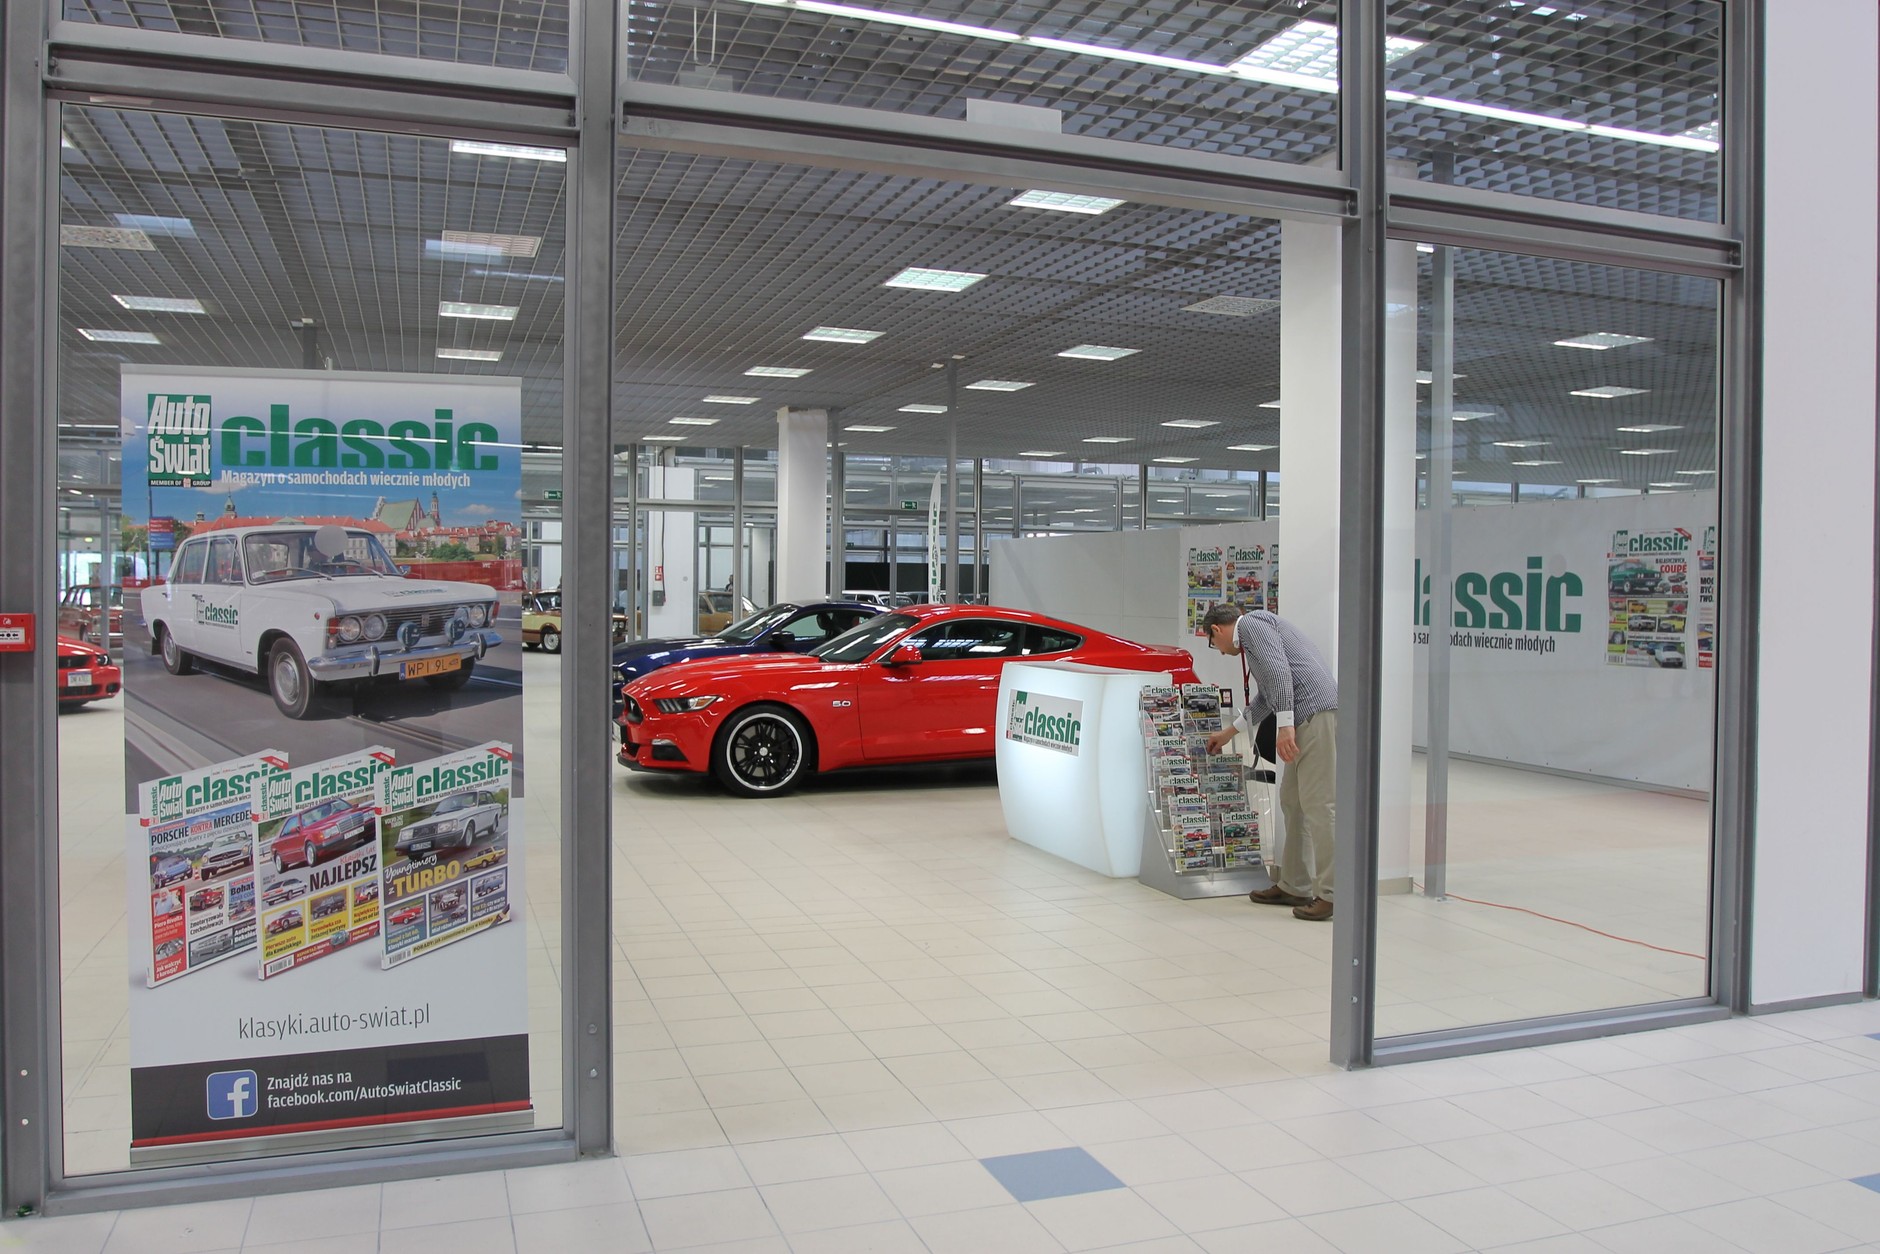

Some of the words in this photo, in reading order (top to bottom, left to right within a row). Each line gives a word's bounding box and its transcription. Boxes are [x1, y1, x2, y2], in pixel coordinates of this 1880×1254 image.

[148, 396, 210, 435] Auto
[221, 404, 498, 470] classic
[149, 435, 211, 474] Świat
[221, 470, 278, 485] Magazyn
[278, 473, 285, 483] o
[288, 470, 367, 485] samochodach
[370, 471, 419, 486] wiecznie
[422, 473, 470, 489] młodych
[1629, 533, 1688, 552] classic
[205, 603, 238, 625] classic
[1474, 632, 1512, 650] wiecznie
[1515, 636, 1555, 655] młodych
[1024, 706, 1080, 745] classic
[270, 777, 291, 796] Auto
[392, 772, 413, 790] Auto
[417, 754, 508, 797] classic
[160, 781, 182, 800] Auto
[151, 826, 189, 846] PORSCHE
[309, 854, 377, 892] NAJLEPSZ
[384, 854, 438, 883] Youngtimery
[388, 887, 395, 895] z
[393, 860, 460, 897] TURBO
[239, 1003, 430, 1040] klasyki.auto-swiat.pl
[267, 1073, 309, 1092] Znajdź
[312, 1074, 333, 1087] nas
[337, 1072, 352, 1083] na
[267, 1077, 461, 1108] facebook.com/AutoSwiatClassic
